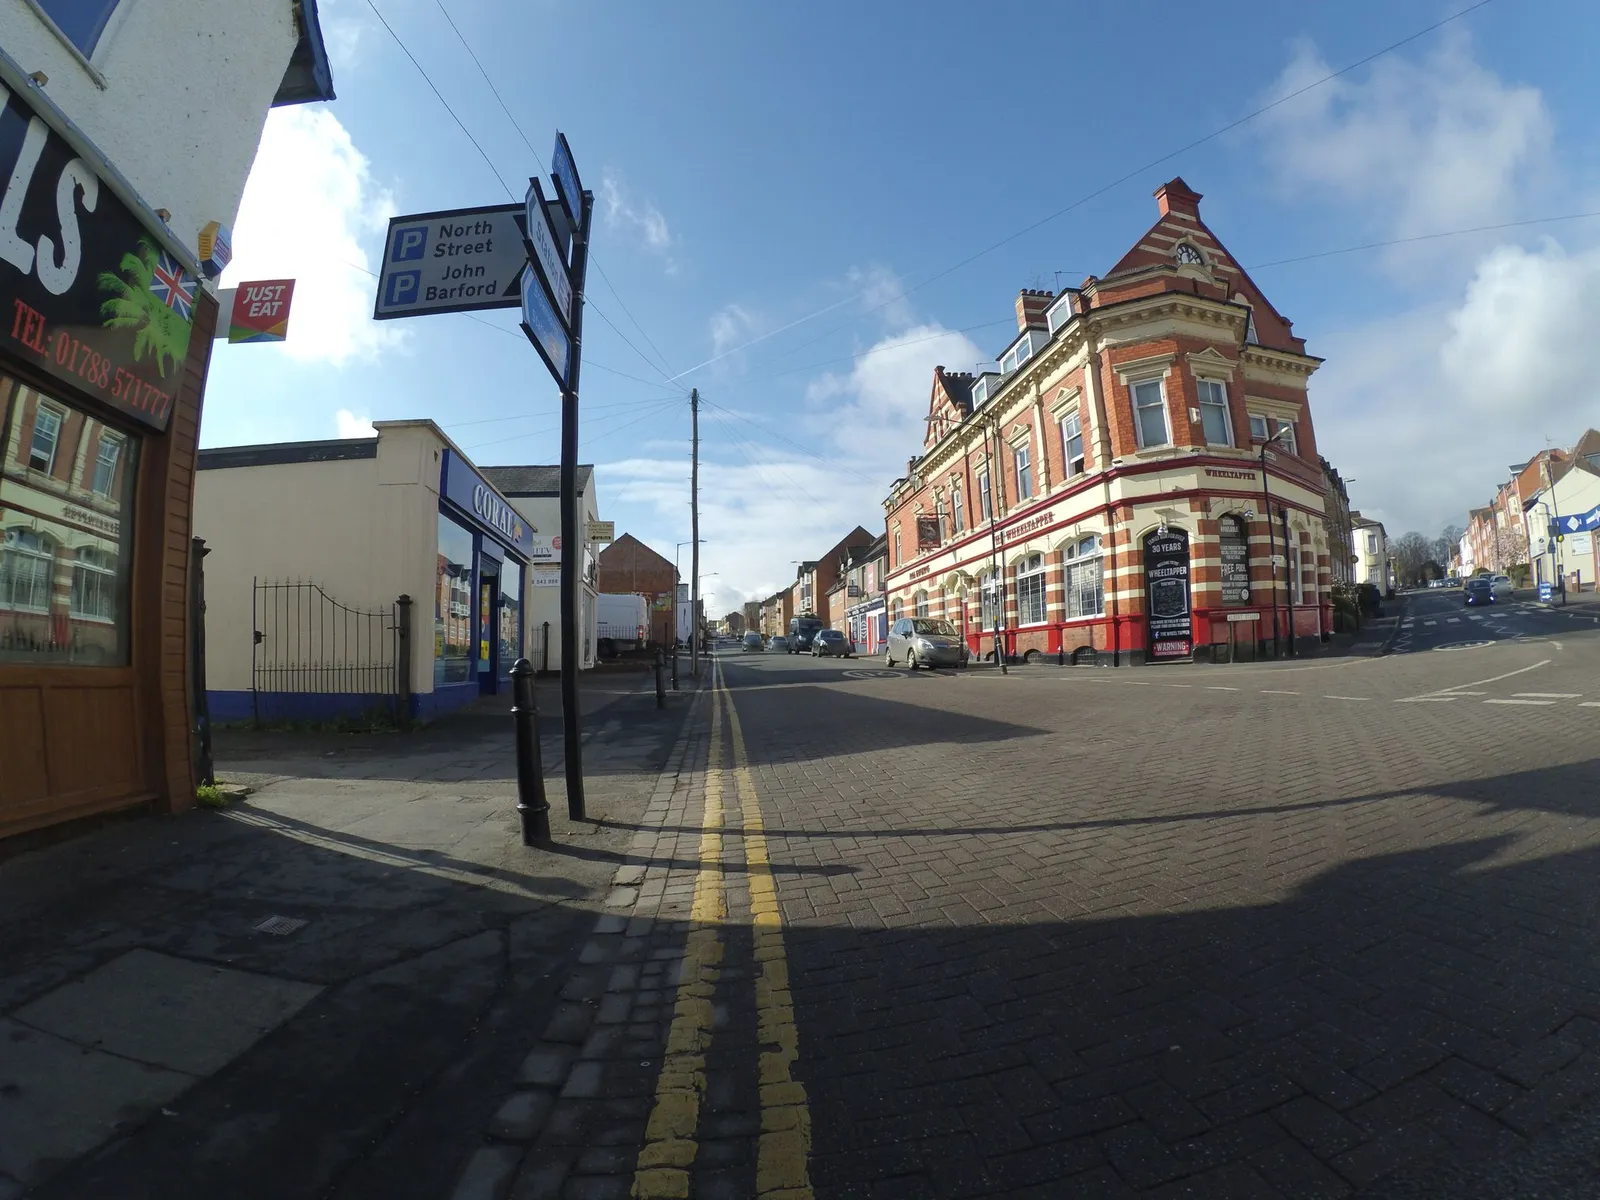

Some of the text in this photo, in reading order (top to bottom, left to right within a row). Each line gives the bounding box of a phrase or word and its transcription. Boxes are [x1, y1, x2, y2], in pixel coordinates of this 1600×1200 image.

[439, 220, 493, 238] North
[433, 239, 493, 258] Street
[536, 220, 560, 287] Station
[441, 264, 485, 280] John
[242, 285, 286, 305] JUST
[425, 280, 497, 301] Barford
[248, 301, 283, 317] EAT
[11, 297, 171, 420] TEL: 01788 571777
[1205, 468, 1256, 480] WHEELTAPPER
[474, 484, 513, 538] CORAL
[1006, 511, 1055, 541] WHEELTAPPER
[1152, 543, 1182, 553] 30 YEARS
[1148, 566, 1187, 578] WHEELTAPPER
[1221, 563, 1235, 577] FREE
[1156, 641, 1186, 652] WARNING
